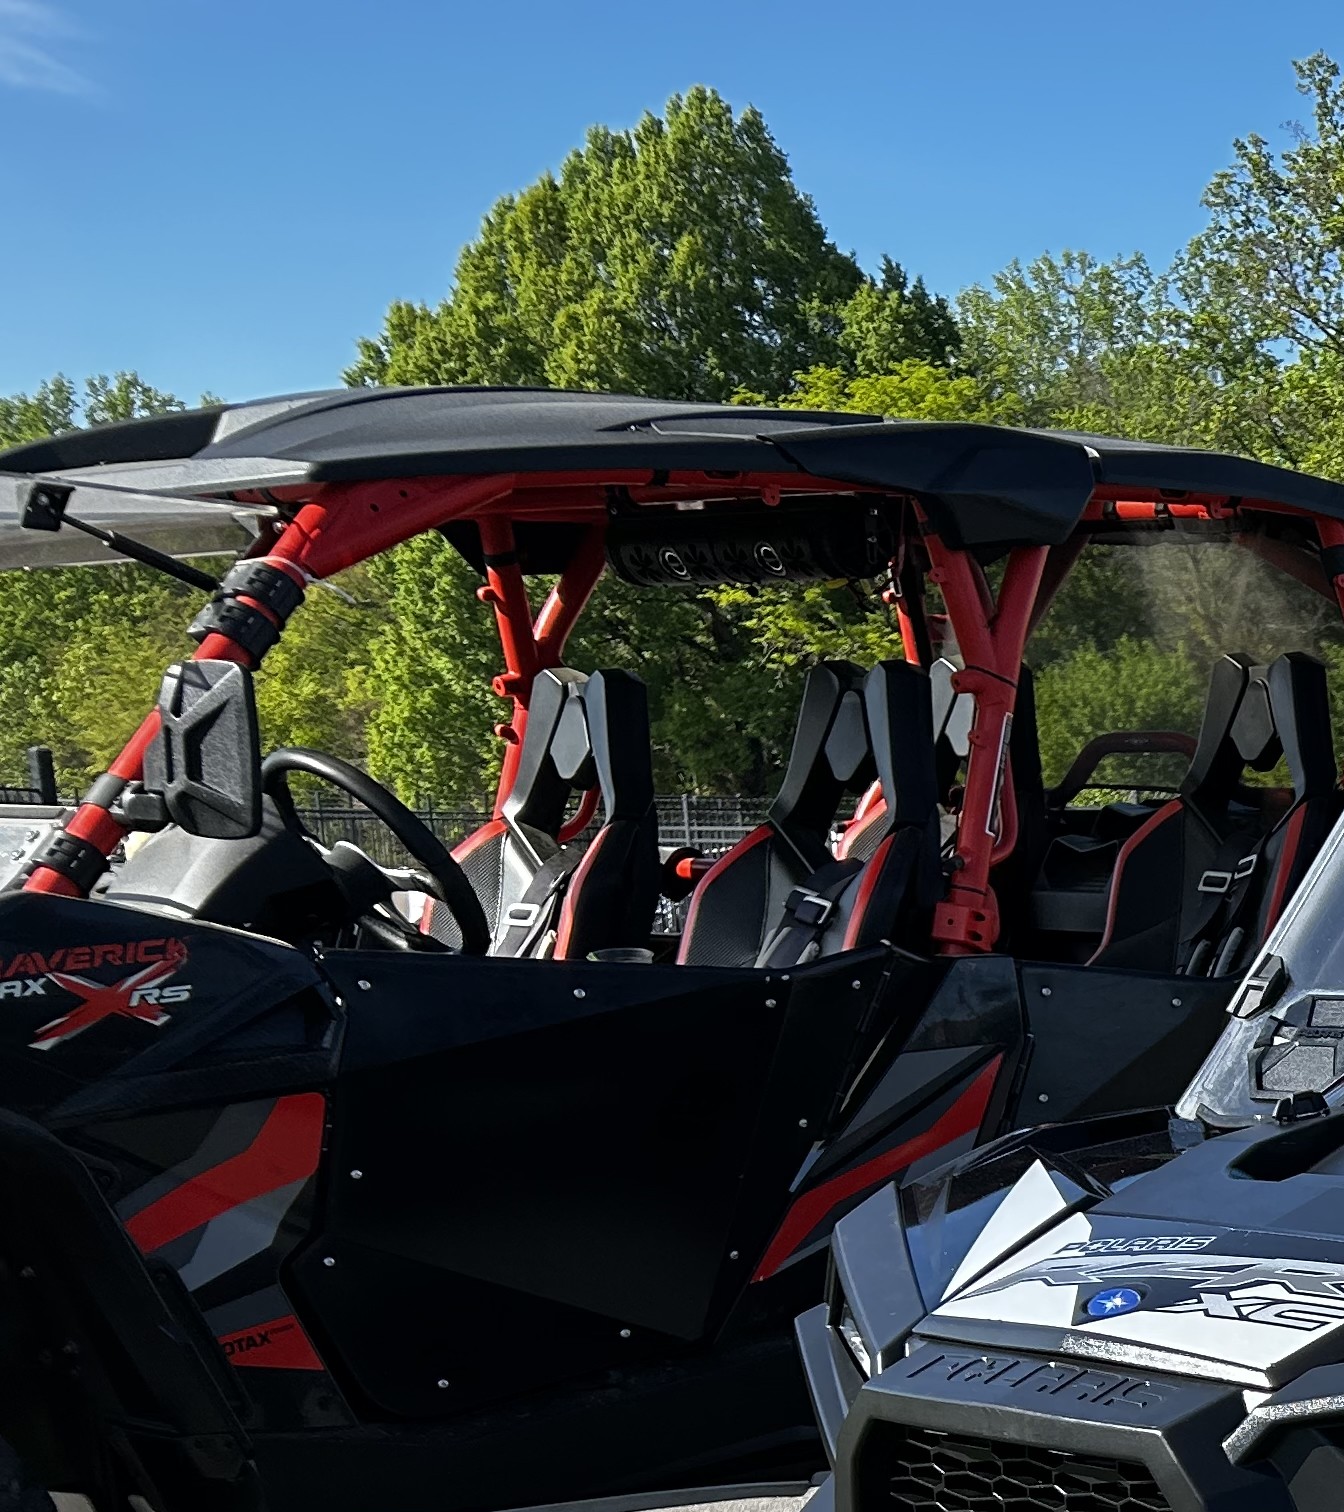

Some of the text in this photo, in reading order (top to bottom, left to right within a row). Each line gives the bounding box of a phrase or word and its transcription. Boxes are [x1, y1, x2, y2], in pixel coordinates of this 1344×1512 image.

[0, 937, 189, 980] AVERICK
[0, 978, 48, 1000] AX
[129, 985, 193, 1007] RS
[1053, 1236, 1217, 1255] POLARIS
[223, 1330, 272, 1356] OTAX
[906, 1354, 1180, 1409] POLARIS
